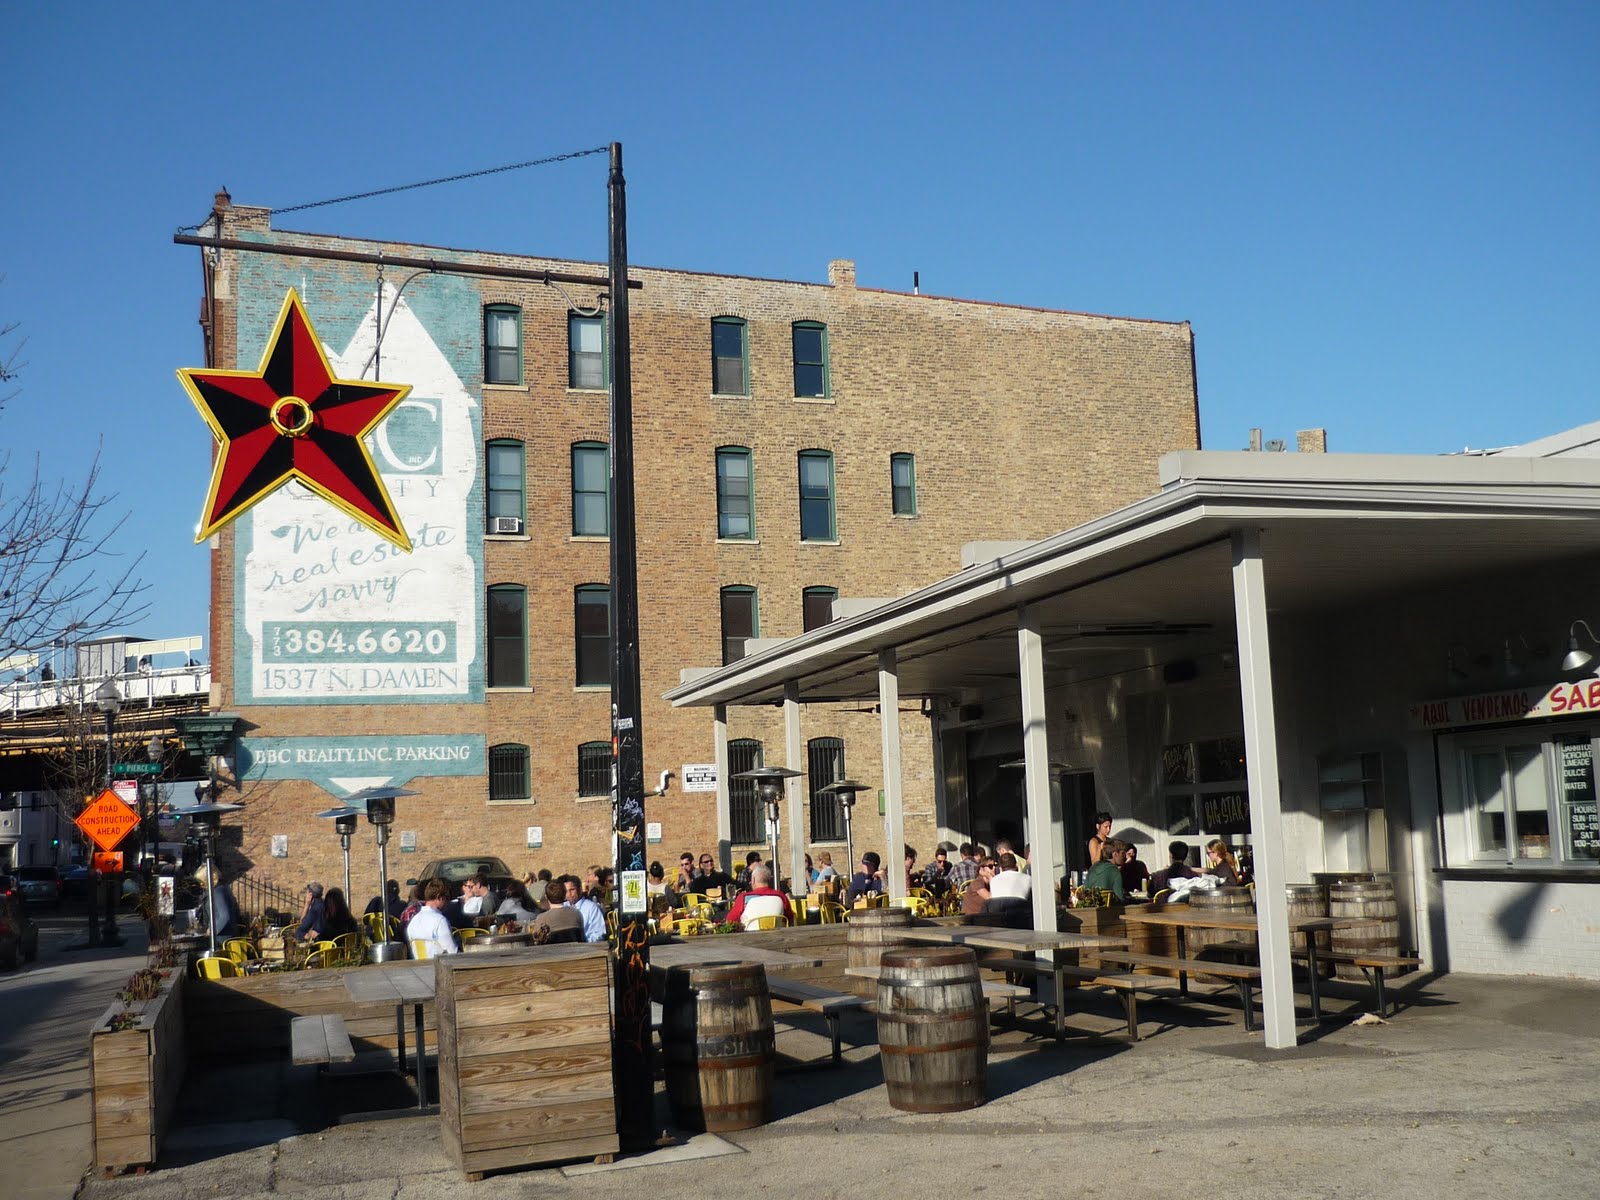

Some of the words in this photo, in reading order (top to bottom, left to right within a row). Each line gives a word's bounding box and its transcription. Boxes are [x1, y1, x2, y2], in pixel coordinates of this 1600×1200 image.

[271, 521, 338, 554] We
[264, 547, 341, 591] real
[295, 568, 426, 613] savvy
[285, 628, 447, 655] 384.6620
[263, 668, 317, 690] 1537
[329, 668, 354, 689] N.
[361, 667, 458, 689] DAMEN
[255, 749, 291, 764] BBC
[396, 746, 471, 760] PARKING
[1563, 751, 1593, 759] HORCHAT
[1564, 769, 1586, 777] DULCE
[1564, 781, 1587, 789] WATER
[98, 805, 119, 813] ROAD
[1221, 795, 1245, 824] STAR
[81, 816, 135, 825] CONSTRUCTION
[96, 827, 121, 836] AHEAD
